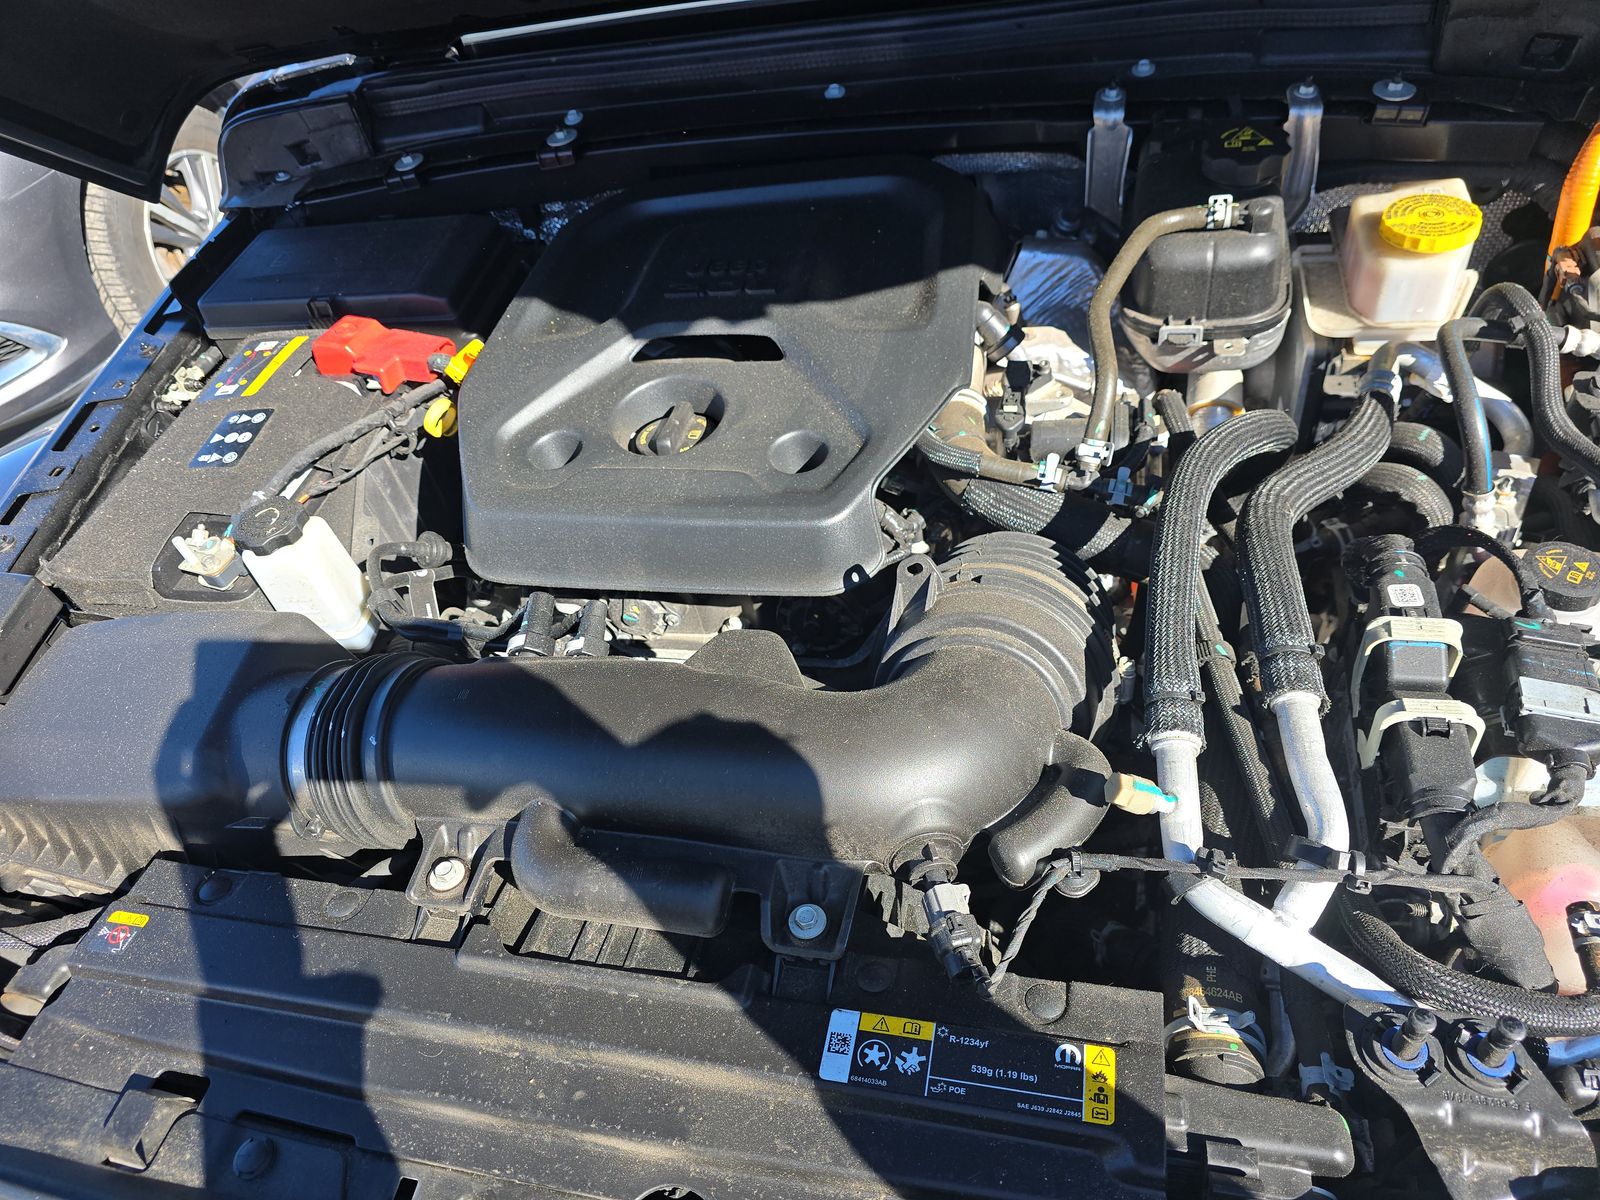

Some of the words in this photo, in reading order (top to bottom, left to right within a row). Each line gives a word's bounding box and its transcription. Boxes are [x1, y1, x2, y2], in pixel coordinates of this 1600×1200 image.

[949, 1034, 990, 1049] R-1234yf
[850, 1075, 887, 1087] 68414033AB
[970, 1064, 993, 1077] 539g
[995, 1068, 1018, 1079] (1.19
[1020, 1071, 1038, 1084] lbs)
[948, 1086, 967, 1095] POE
[1016, 1102, 1030, 1110] SAE
[1045, 1107, 1063, 1115] J2842
[1064, 1109, 1082, 1118] J2845
